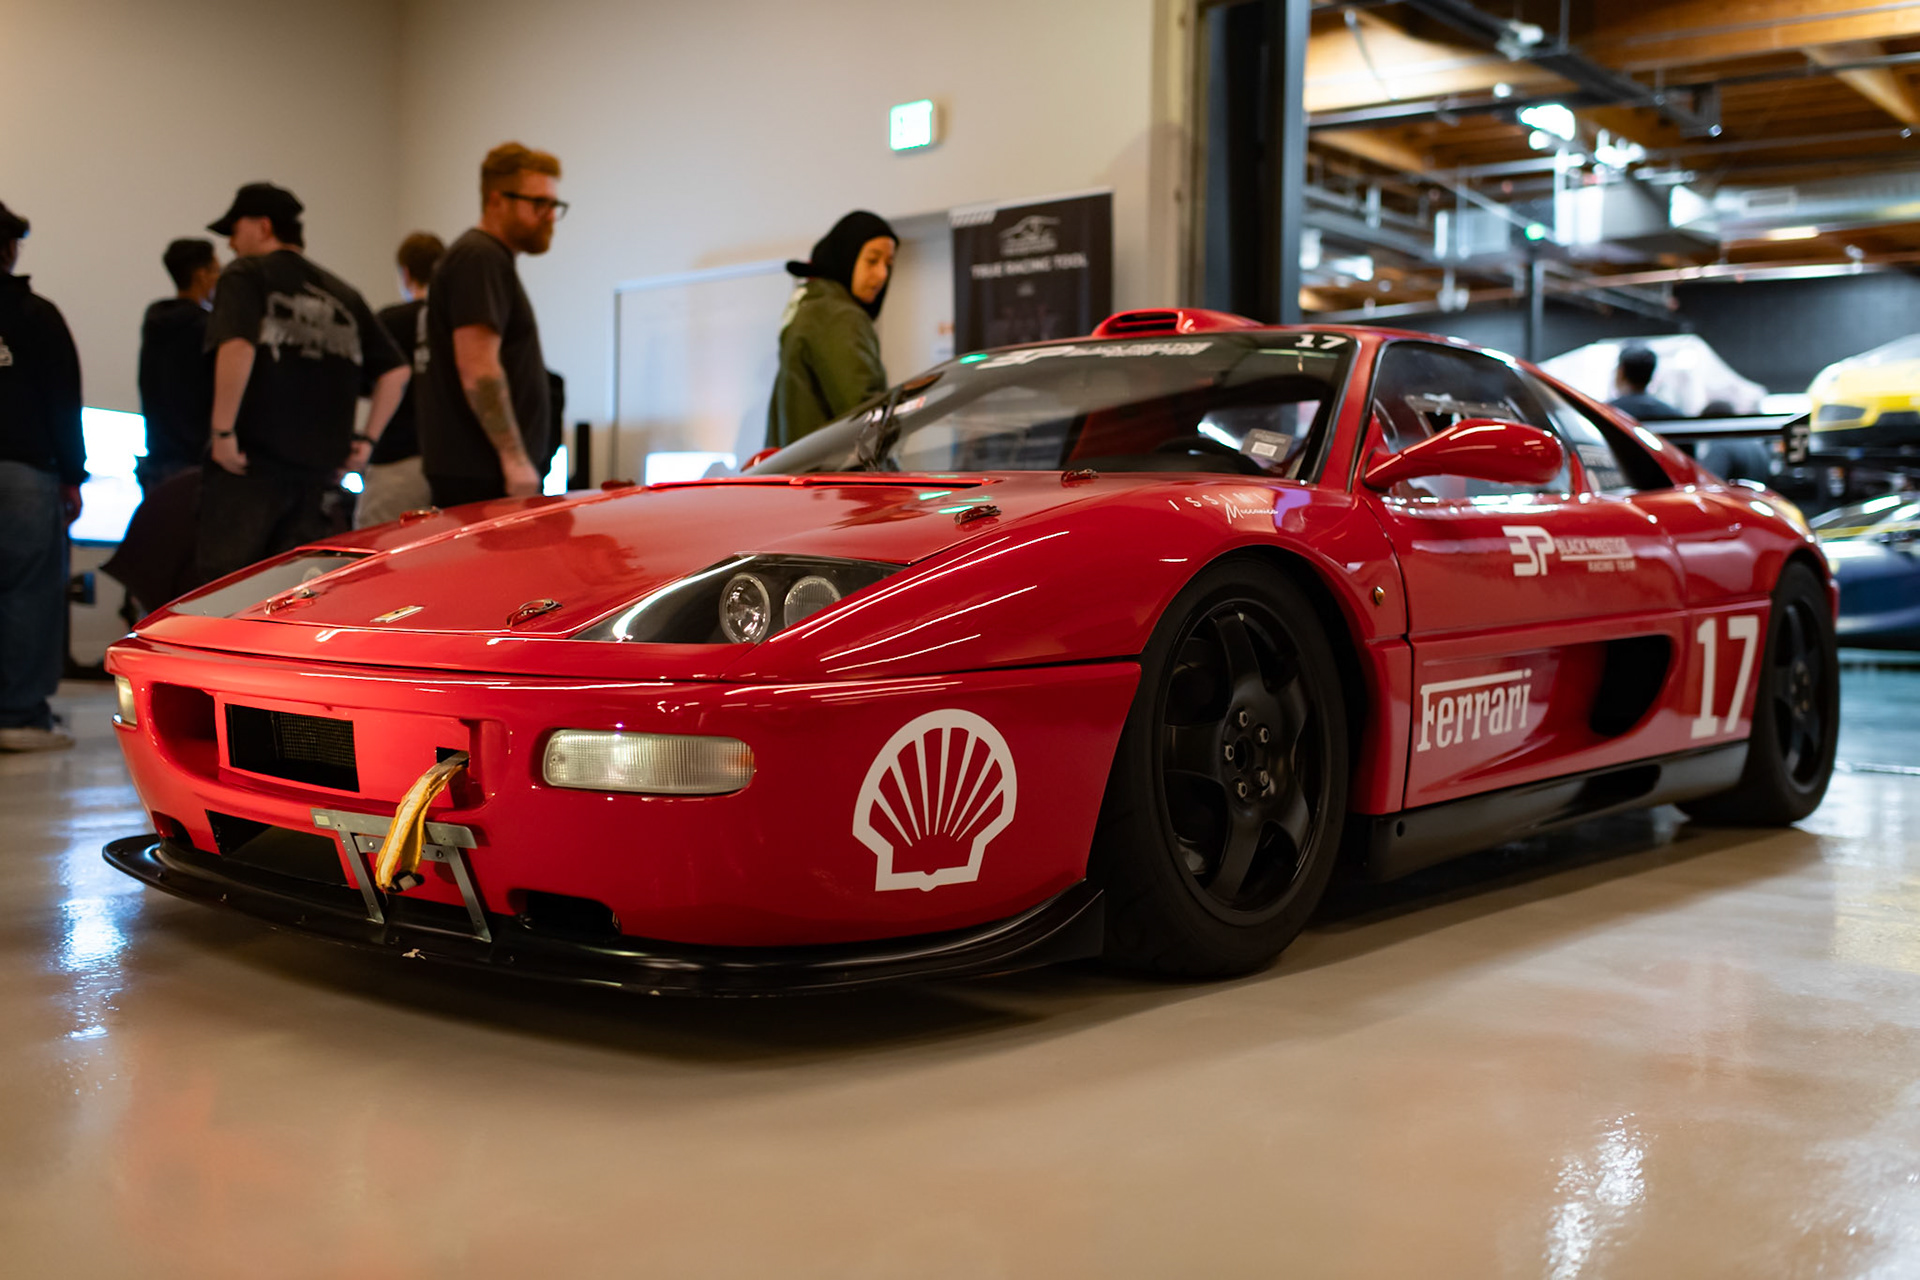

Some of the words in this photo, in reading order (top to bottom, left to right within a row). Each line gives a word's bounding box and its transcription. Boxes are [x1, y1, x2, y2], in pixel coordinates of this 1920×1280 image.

[1295, 334, 1347, 349] 17
[1416, 668, 1533, 752] Ferrari
[1690, 615, 1759, 740] 17
